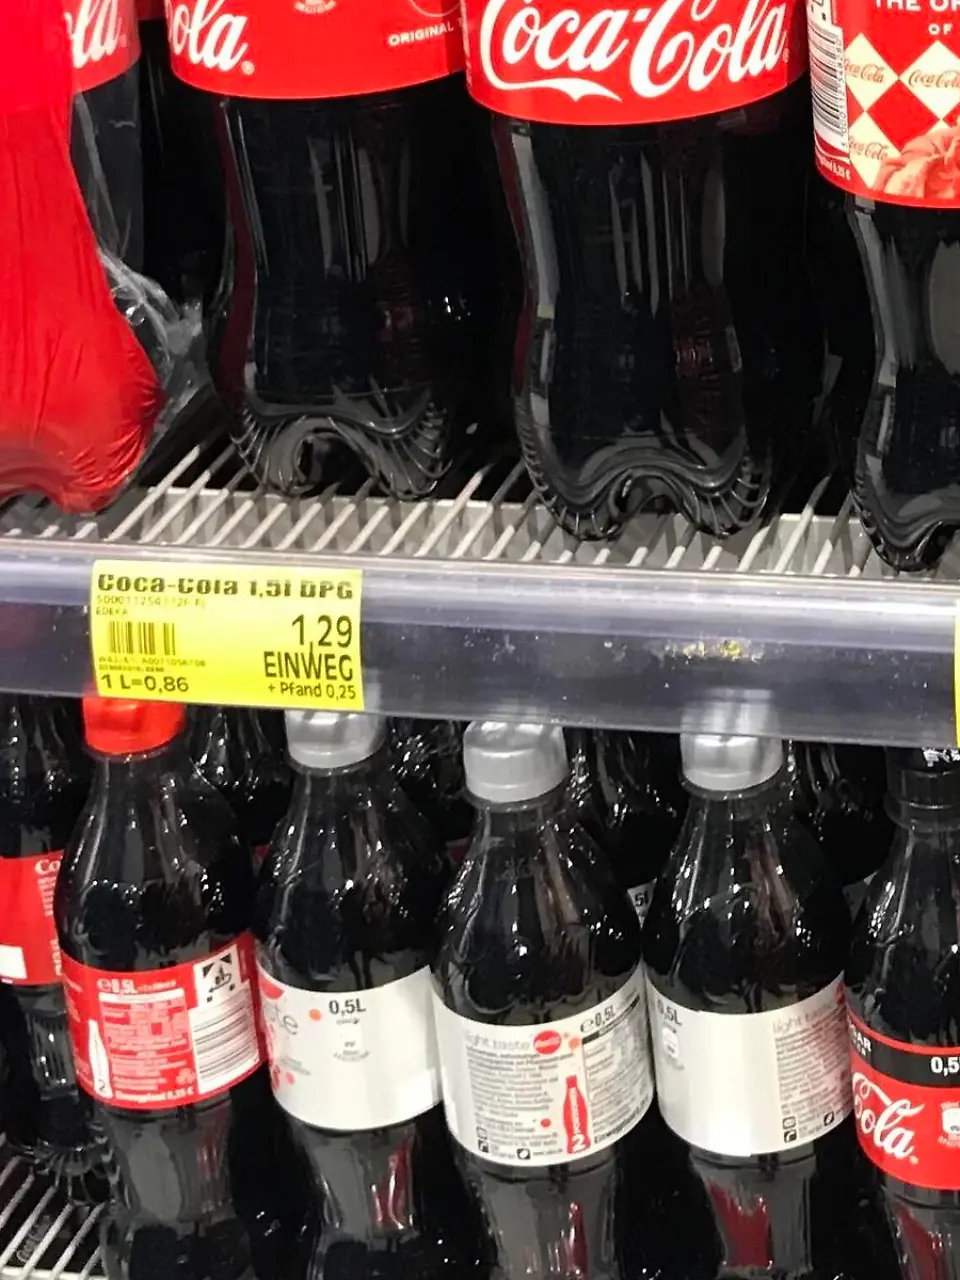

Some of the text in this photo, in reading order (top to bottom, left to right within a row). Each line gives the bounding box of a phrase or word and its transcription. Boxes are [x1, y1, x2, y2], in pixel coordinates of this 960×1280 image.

[388, 21, 454, 47] ORIGINAL
[928, 23, 953, 37] OF
[908, 68, 959, 89] Coca-Col
[98, 574, 239, 596] Coca-Cola
[300, 581, 353, 600] DPG
[292, 614, 352, 650] 1,29
[263, 650, 353, 682] EINWEG
[101, 674, 189, 694] 1 L=0,86
[281, 682, 322, 698] Pfand
[326, 684, 356, 701] 0,25
[328, 998, 367, 1017] 0,5L
[572, 1133, 586, 1152] 2
